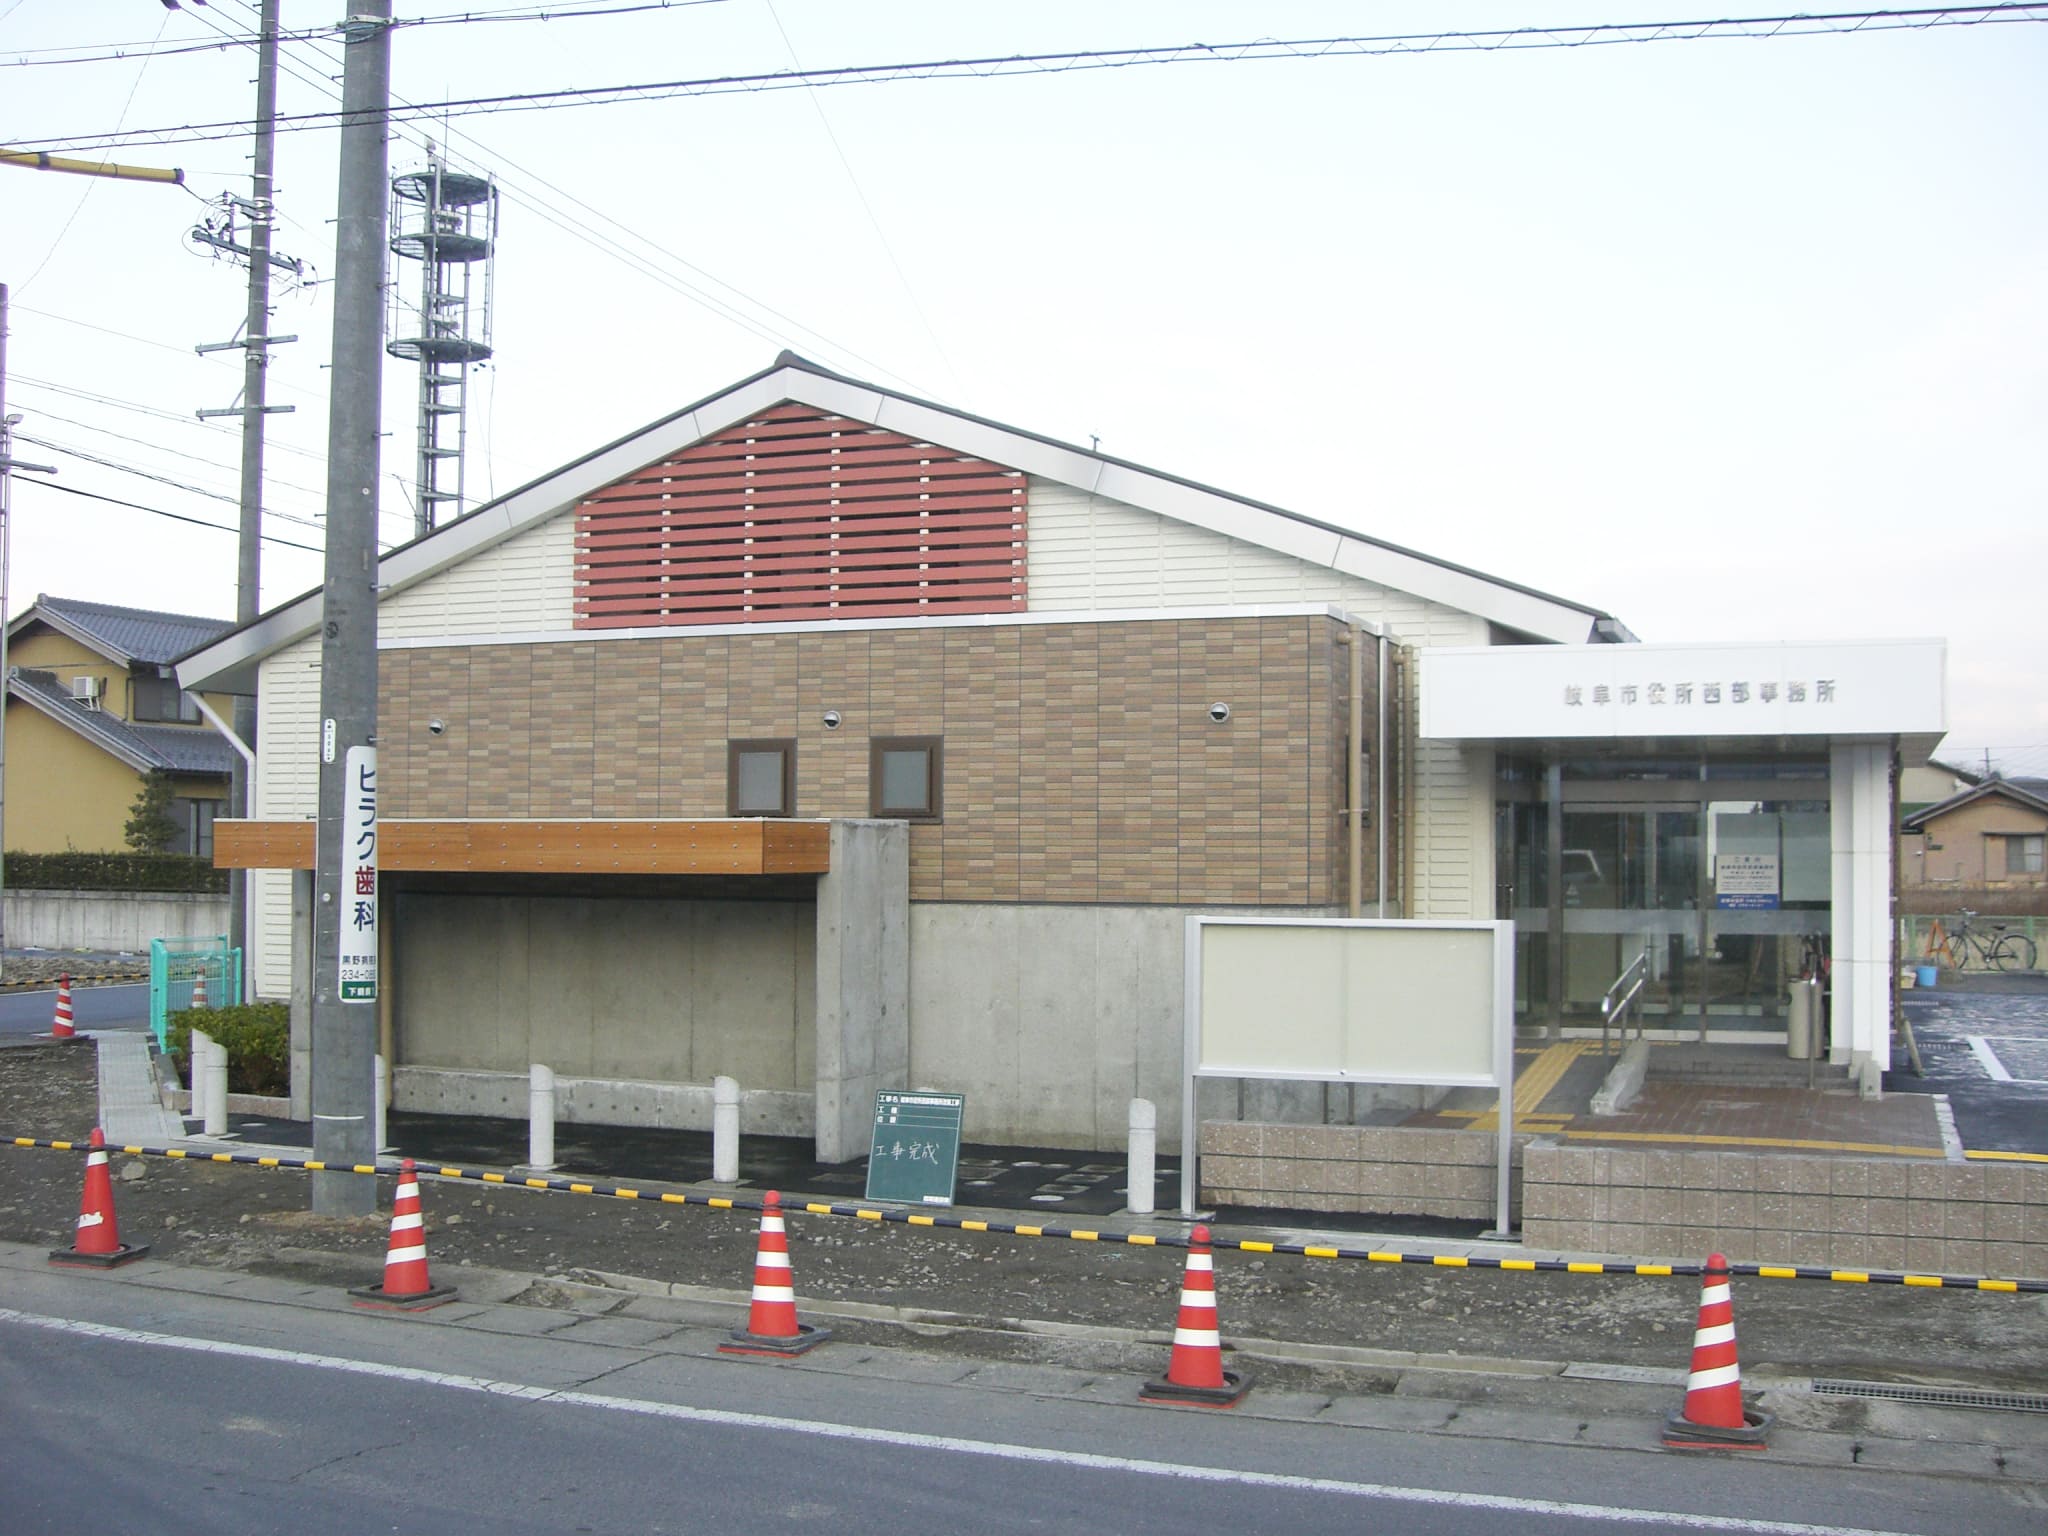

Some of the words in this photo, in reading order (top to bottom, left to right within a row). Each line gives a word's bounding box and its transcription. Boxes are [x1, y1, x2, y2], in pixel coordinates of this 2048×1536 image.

[1564, 679, 1836, 706] 岐阜市役所西部事務所
[354, 763, 376, 931] ヒラク歯科
[875, 1140, 940, 1165] 工事完成
